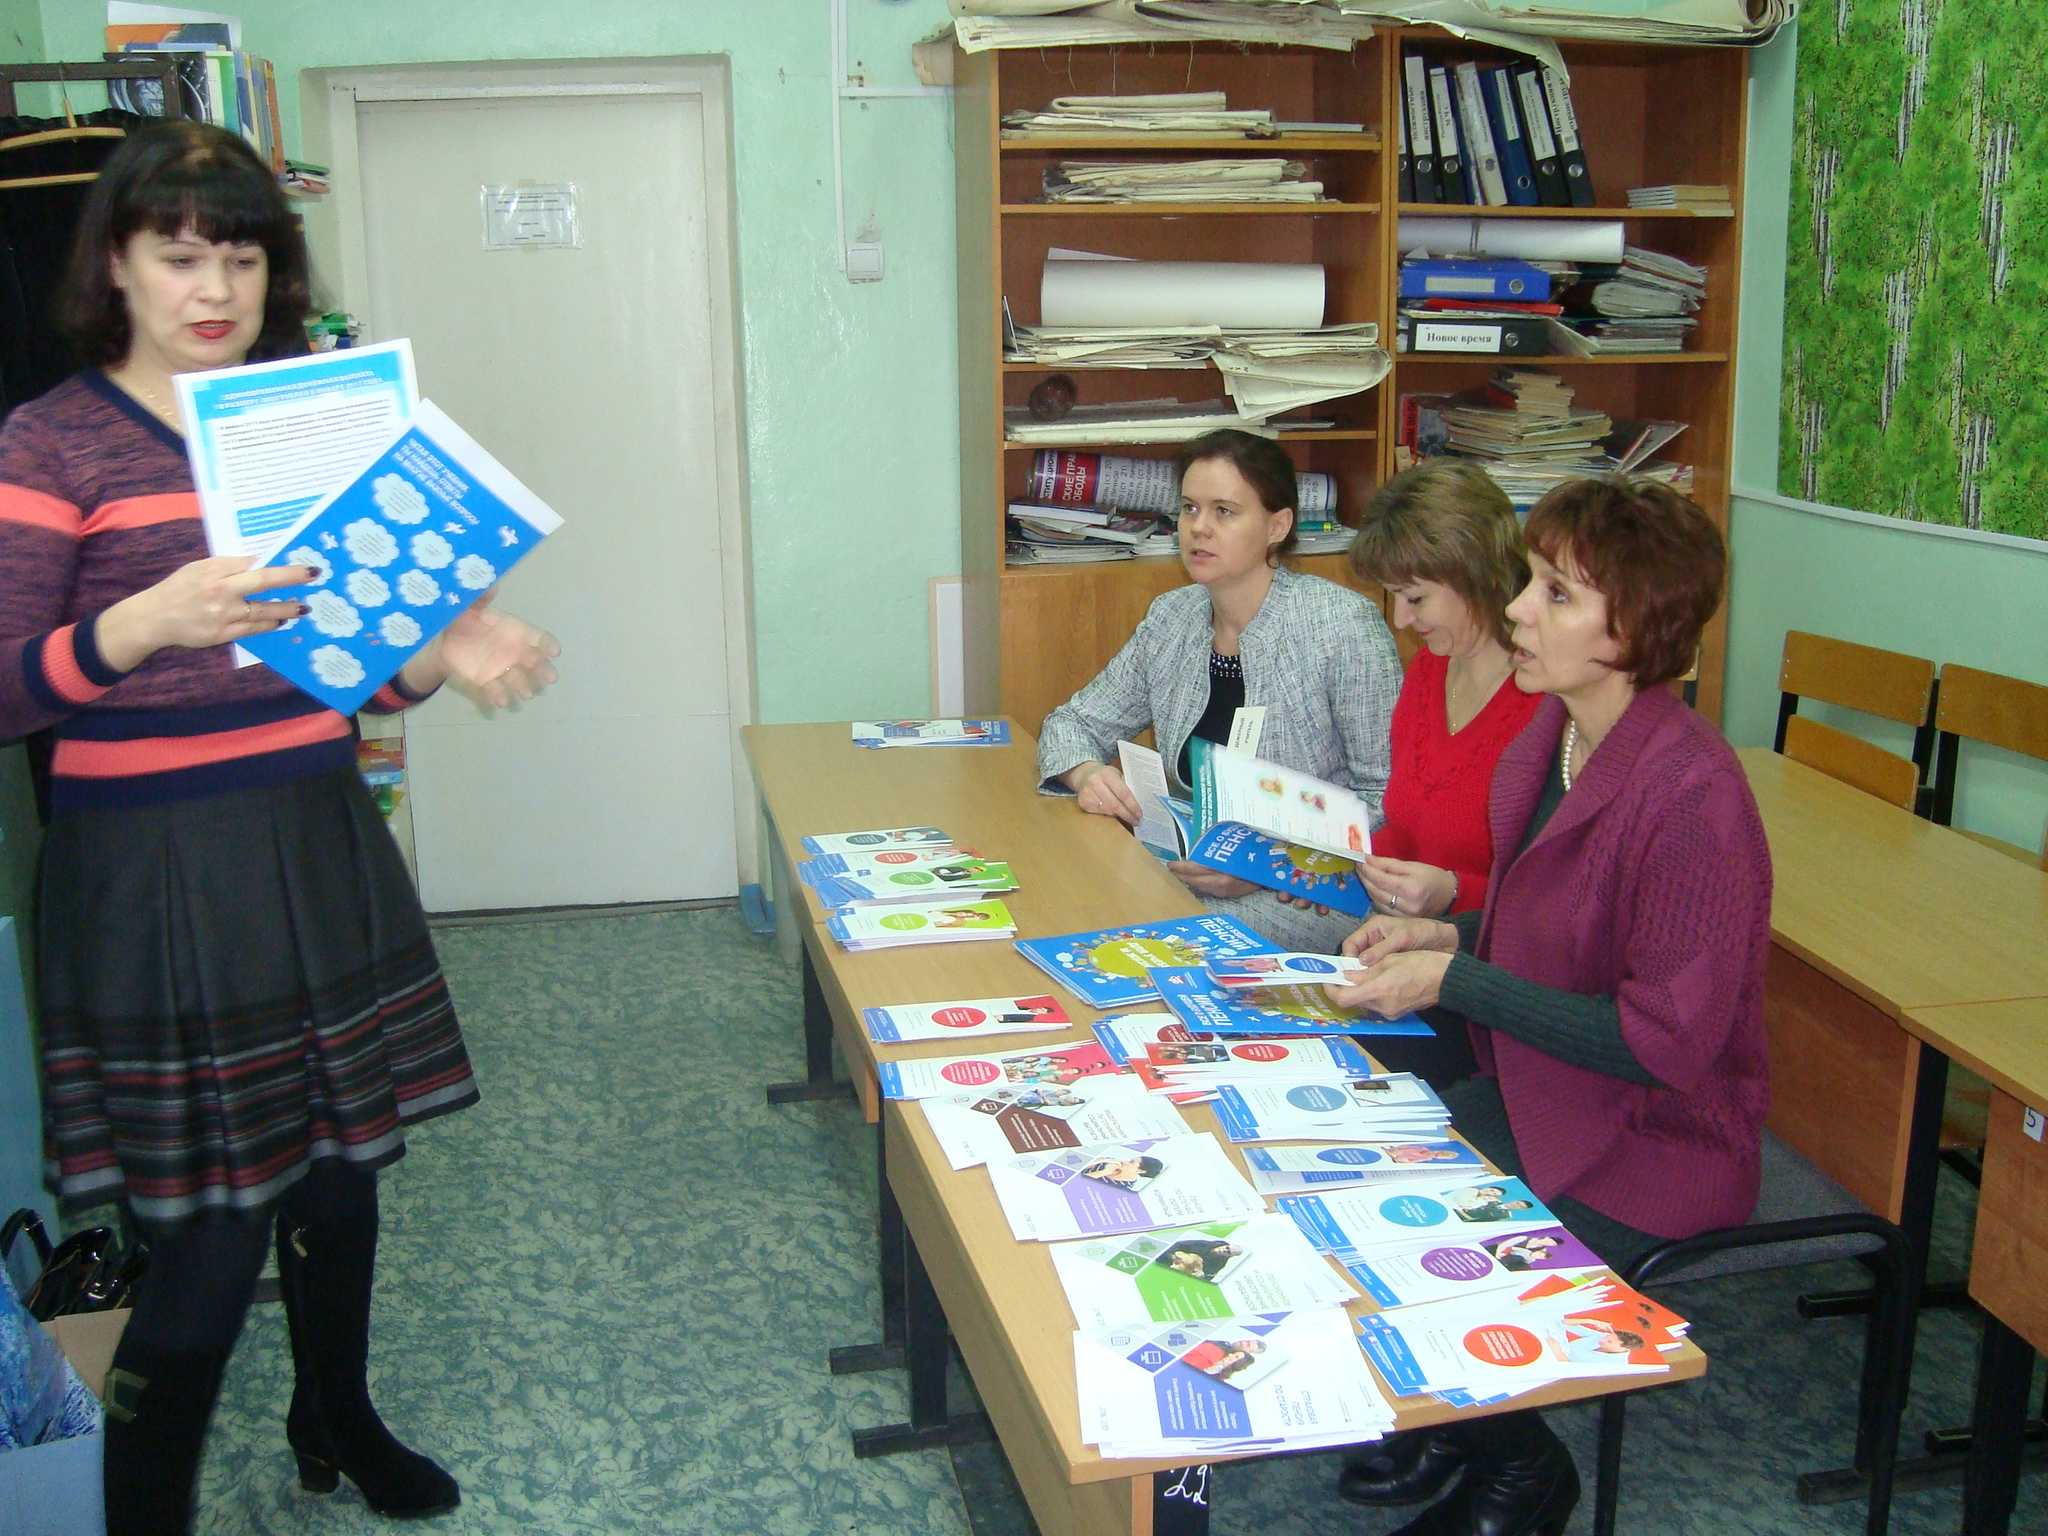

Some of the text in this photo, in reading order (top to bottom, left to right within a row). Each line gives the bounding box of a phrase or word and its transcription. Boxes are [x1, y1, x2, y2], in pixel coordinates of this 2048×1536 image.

[1427, 332, 1493, 345] Новое время
[1062, 476, 1074, 500] СКИЕ
[1072, 465, 1087, 501] ОБОДЫ
[1203, 841, 1219, 857] ВСЕ
[1215, 833, 1225, 842] О
[1195, 917, 1251, 950] ПЕНСИИ
[1191, 994, 1233, 1026] ПЕНСИИ
[2026, 1107, 2036, 1128] 5
[1168, 1198, 1183, 1216] ПОТЕРИ
[1273, 1385, 1291, 1426] ПО СТАРОСТИ
[1290, 1401, 1304, 1425] ПЕНСИЯ
[1300, 1390, 1318, 1424] СТРАХОВАЯ
